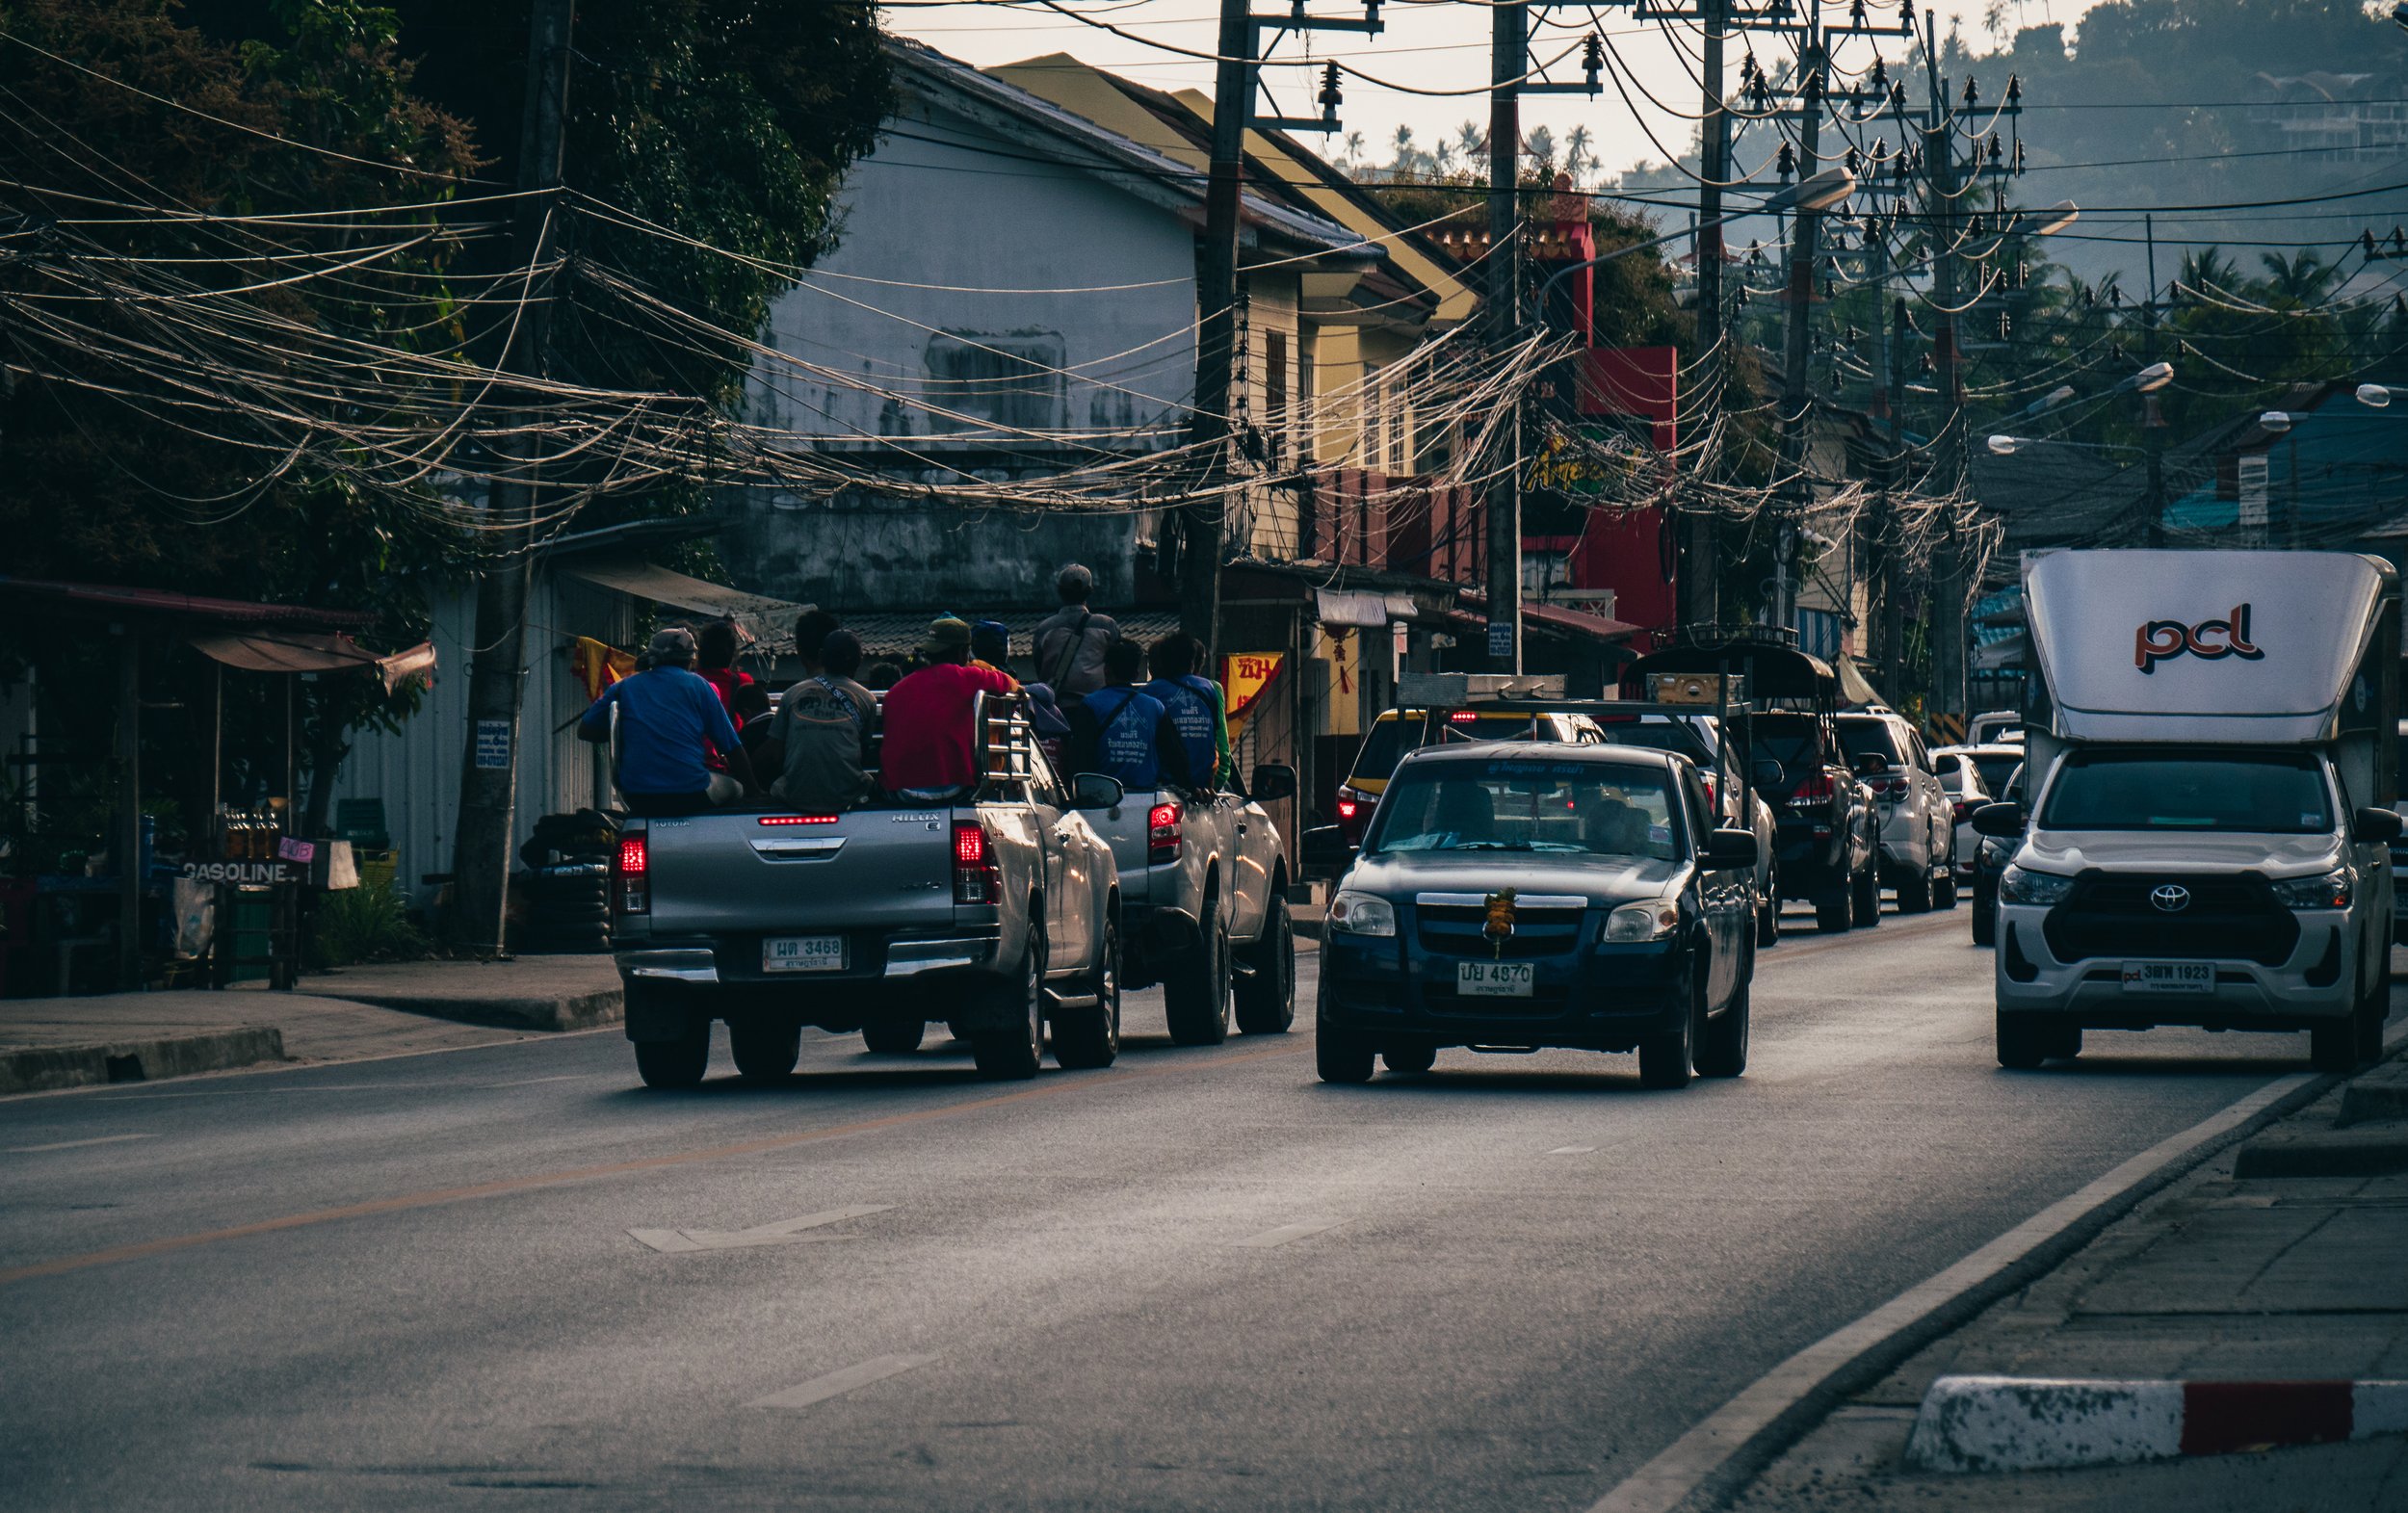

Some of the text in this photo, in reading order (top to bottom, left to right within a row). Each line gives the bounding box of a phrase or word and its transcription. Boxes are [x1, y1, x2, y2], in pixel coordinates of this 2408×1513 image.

[2134, 603, 2265, 675] pcl
[892, 813, 941, 822] HILUX
[183, 862, 288, 882] GASOLINE
[805, 940, 840, 954] 3468
[1490, 964, 1531, 982] 4870
[2177, 966, 2210, 979] 1923
